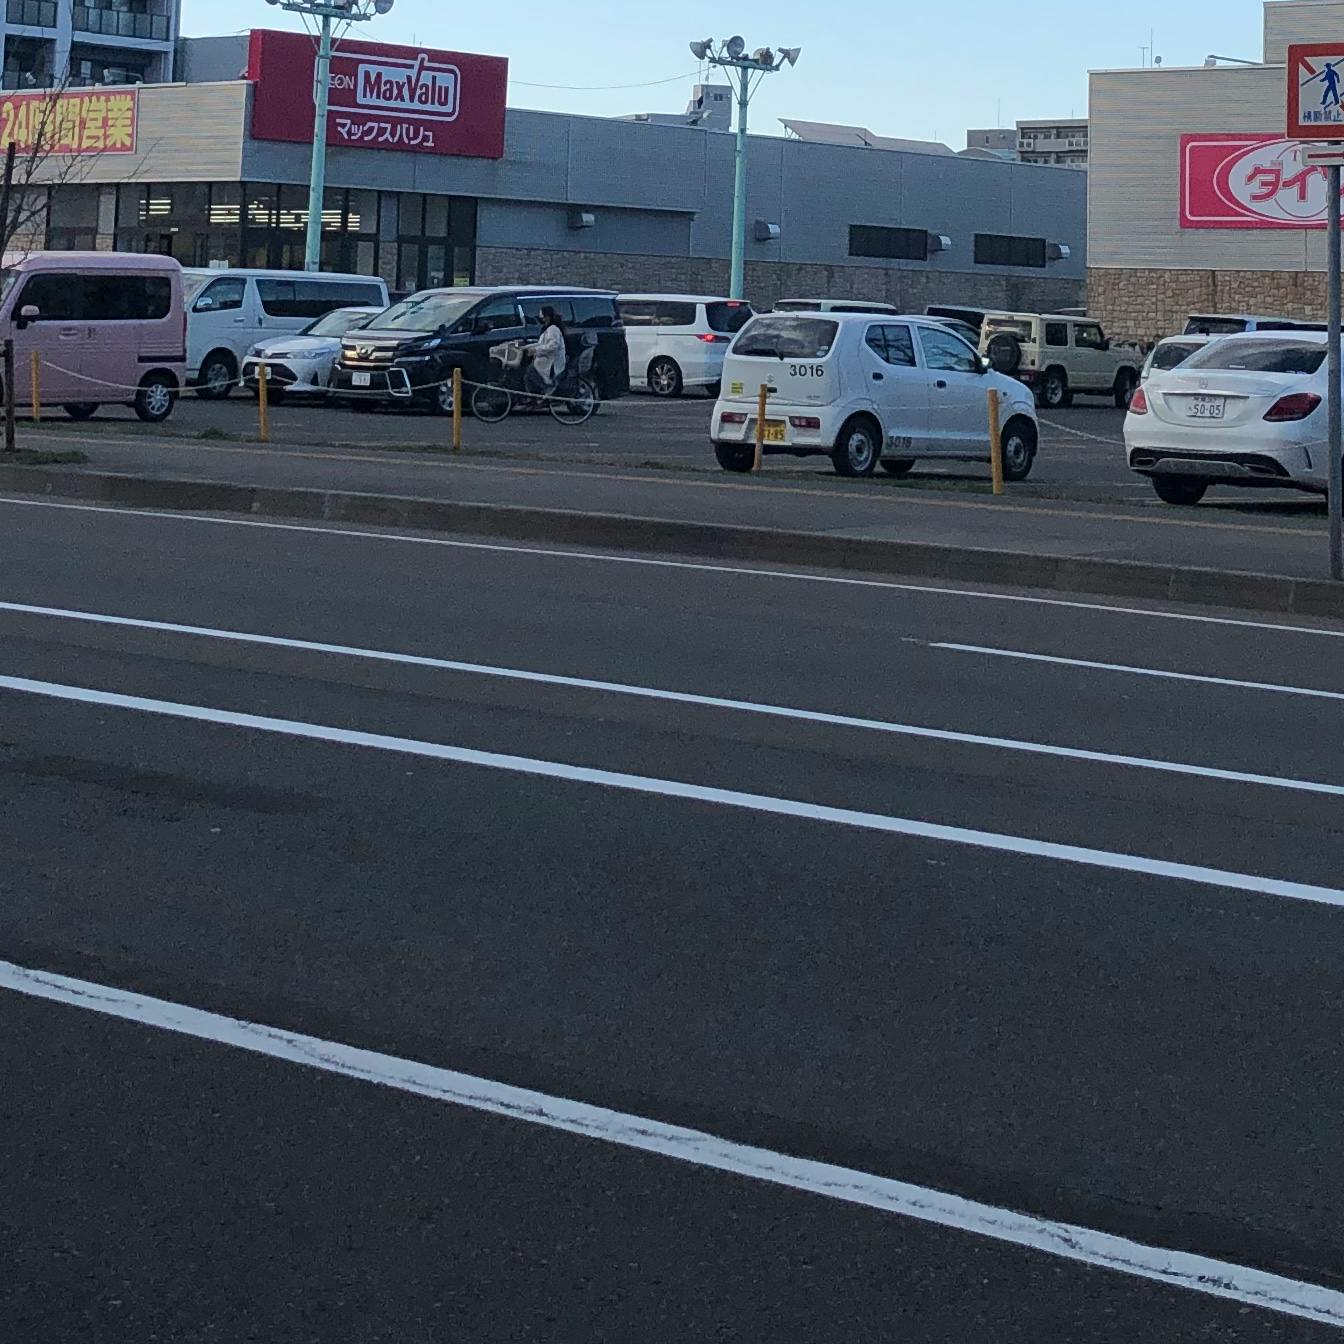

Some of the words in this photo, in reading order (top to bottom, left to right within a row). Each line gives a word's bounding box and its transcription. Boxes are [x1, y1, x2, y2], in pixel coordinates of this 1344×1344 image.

[362, 57, 449, 107] MaxValu
[0, 94, 134, 150] 24時間営業
[1303, 109, 1343, 123] 横断禁止
[335, 118, 435, 147] マックスバリュ
[789, 364, 824, 377] 3016
[887, 435, 912, 448] 3016
